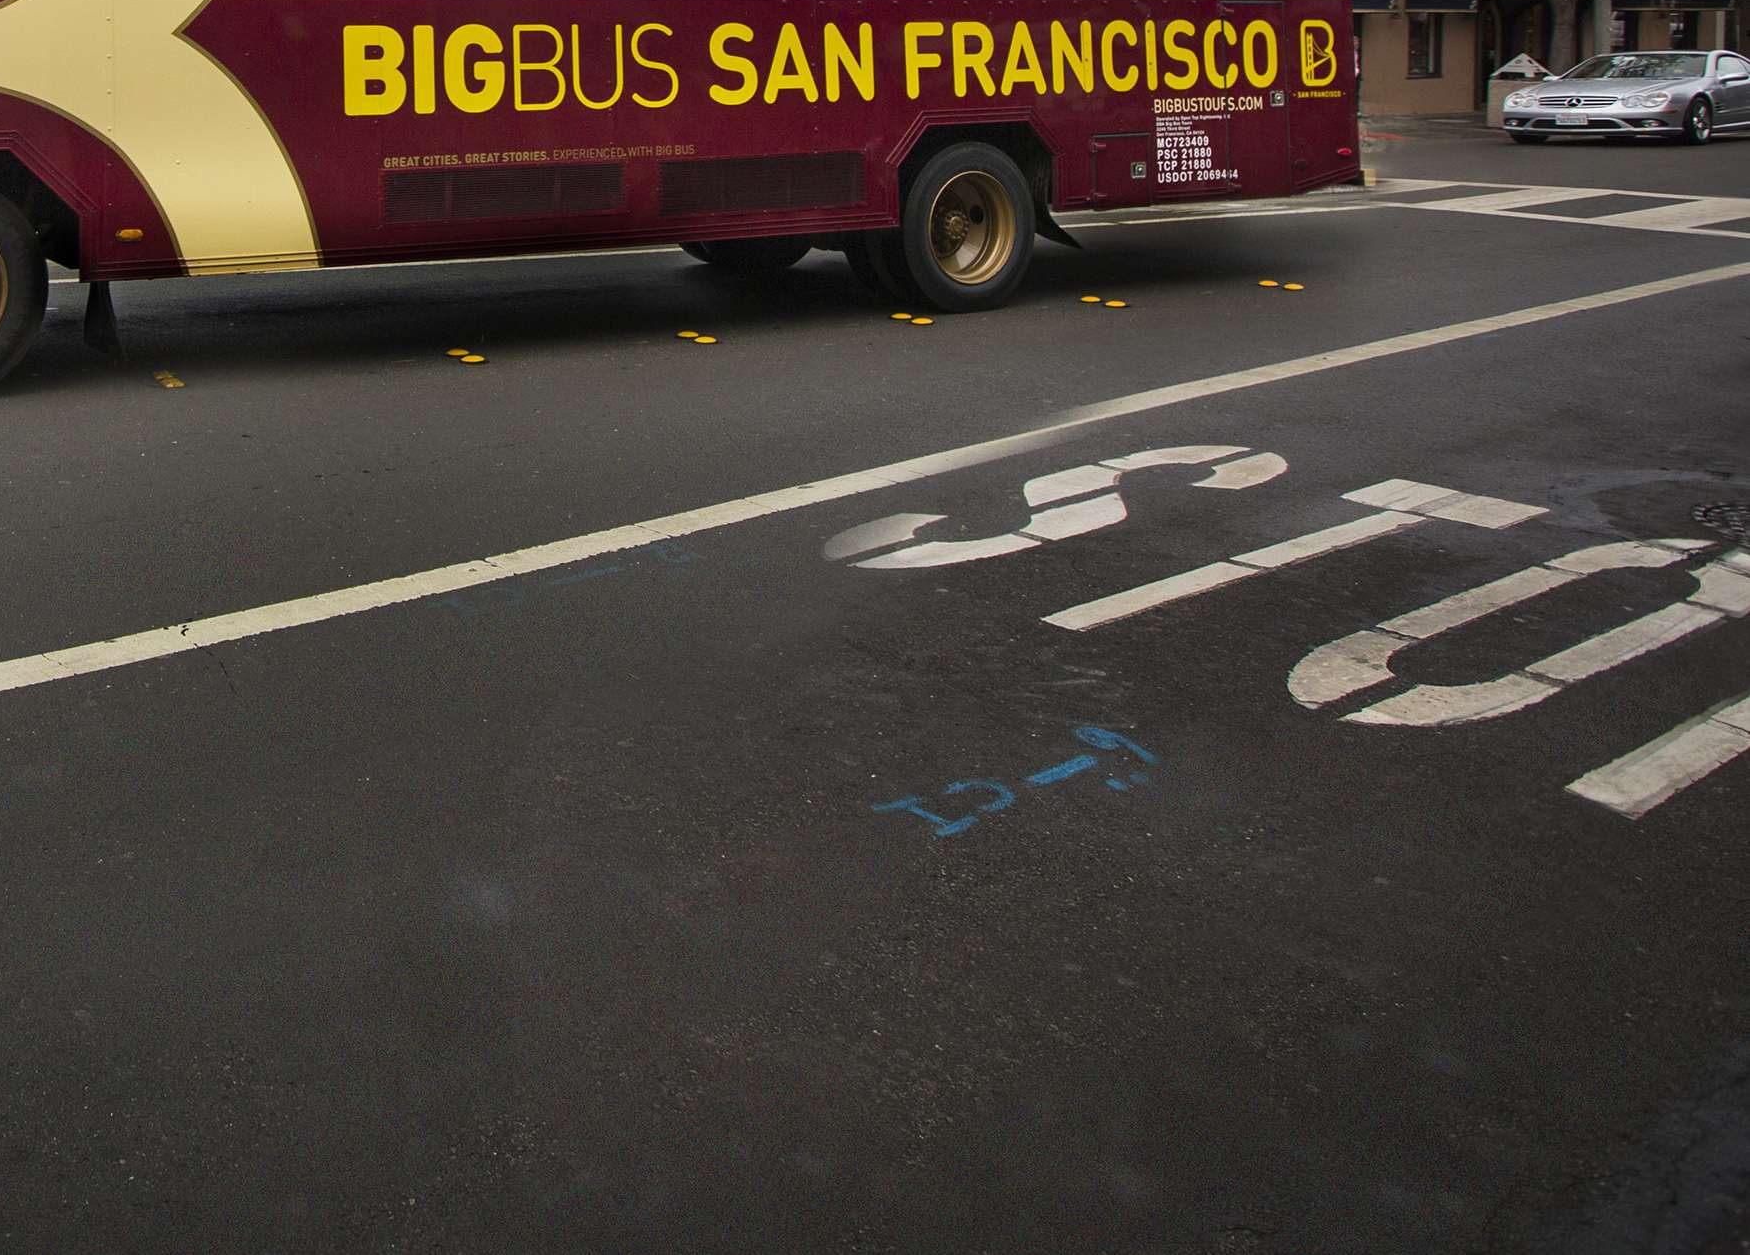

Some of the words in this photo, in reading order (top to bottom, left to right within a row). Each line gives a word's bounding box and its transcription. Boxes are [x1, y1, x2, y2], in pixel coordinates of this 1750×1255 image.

[709, 22, 875, 105] SAN
[904, 19, 1279, 99] FRANCISCO
[1310, 90, 1342, 98] FRANCISCO
[1157, 136, 1209, 148] MC723409
[383, 156, 420, 168] GREAT
[422, 154, 462, 166] CITIES.
[465, 153, 500, 164] GREAT
[502, 151, 550, 162] STORIES.
[628, 146, 652, 156] WITH
[656, 145, 672, 156] BIG
[674, 144, 695, 155] BUS
[1157, 149, 1178, 160] PSC
[1181, 147, 1212, 159] 21880
[1157, 160, 1177, 171] TCP
[1181, 159, 1212, 170] 21880
[1157, 172, 1193, 183] USDOT
